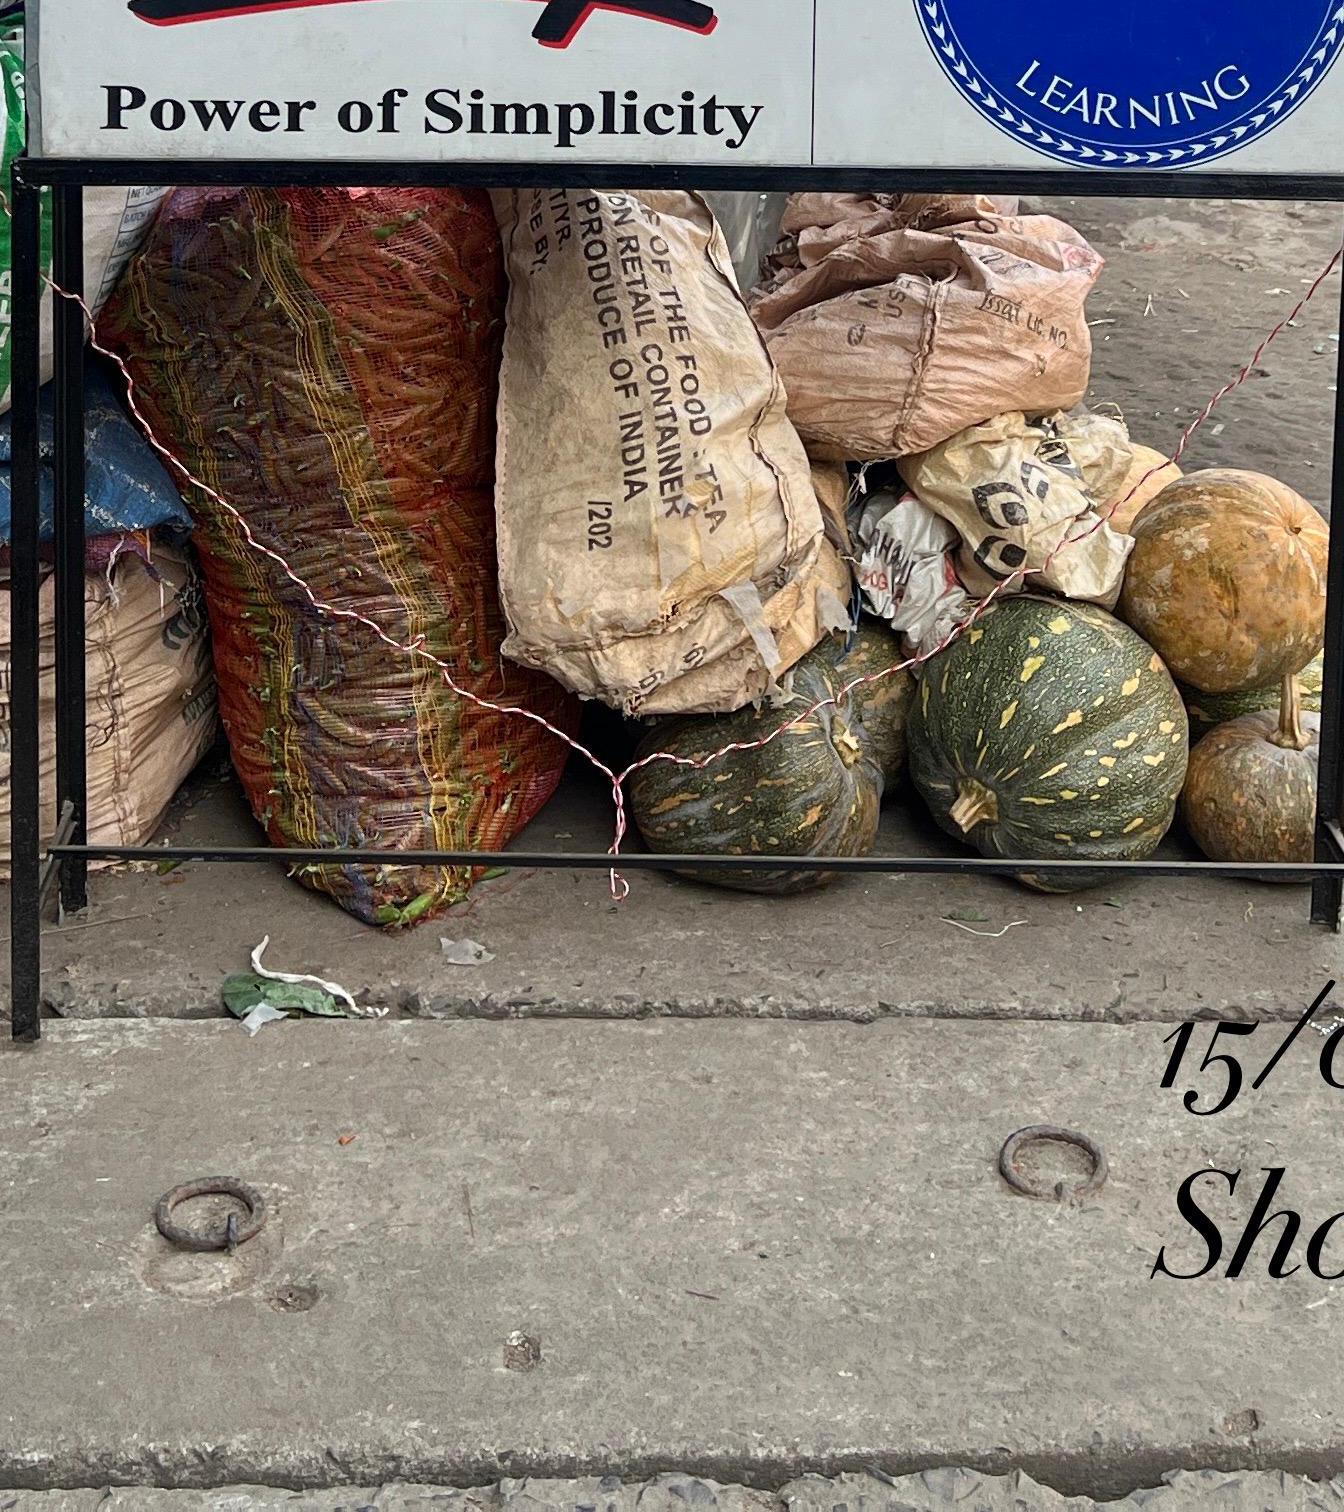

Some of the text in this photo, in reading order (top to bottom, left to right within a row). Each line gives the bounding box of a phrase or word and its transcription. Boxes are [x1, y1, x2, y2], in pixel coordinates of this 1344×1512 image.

[98, 85, 765, 150] Power of Simplicity
[1014, 58, 1252, 131] LEARNING
[616, 234, 657, 338] RETAIL
[649, 234, 673, 276] OF
[575, 196, 649, 504] PRODUCE OF INDIA
[658, 284, 692, 344] THE
[675, 353, 712, 437] FOOD
